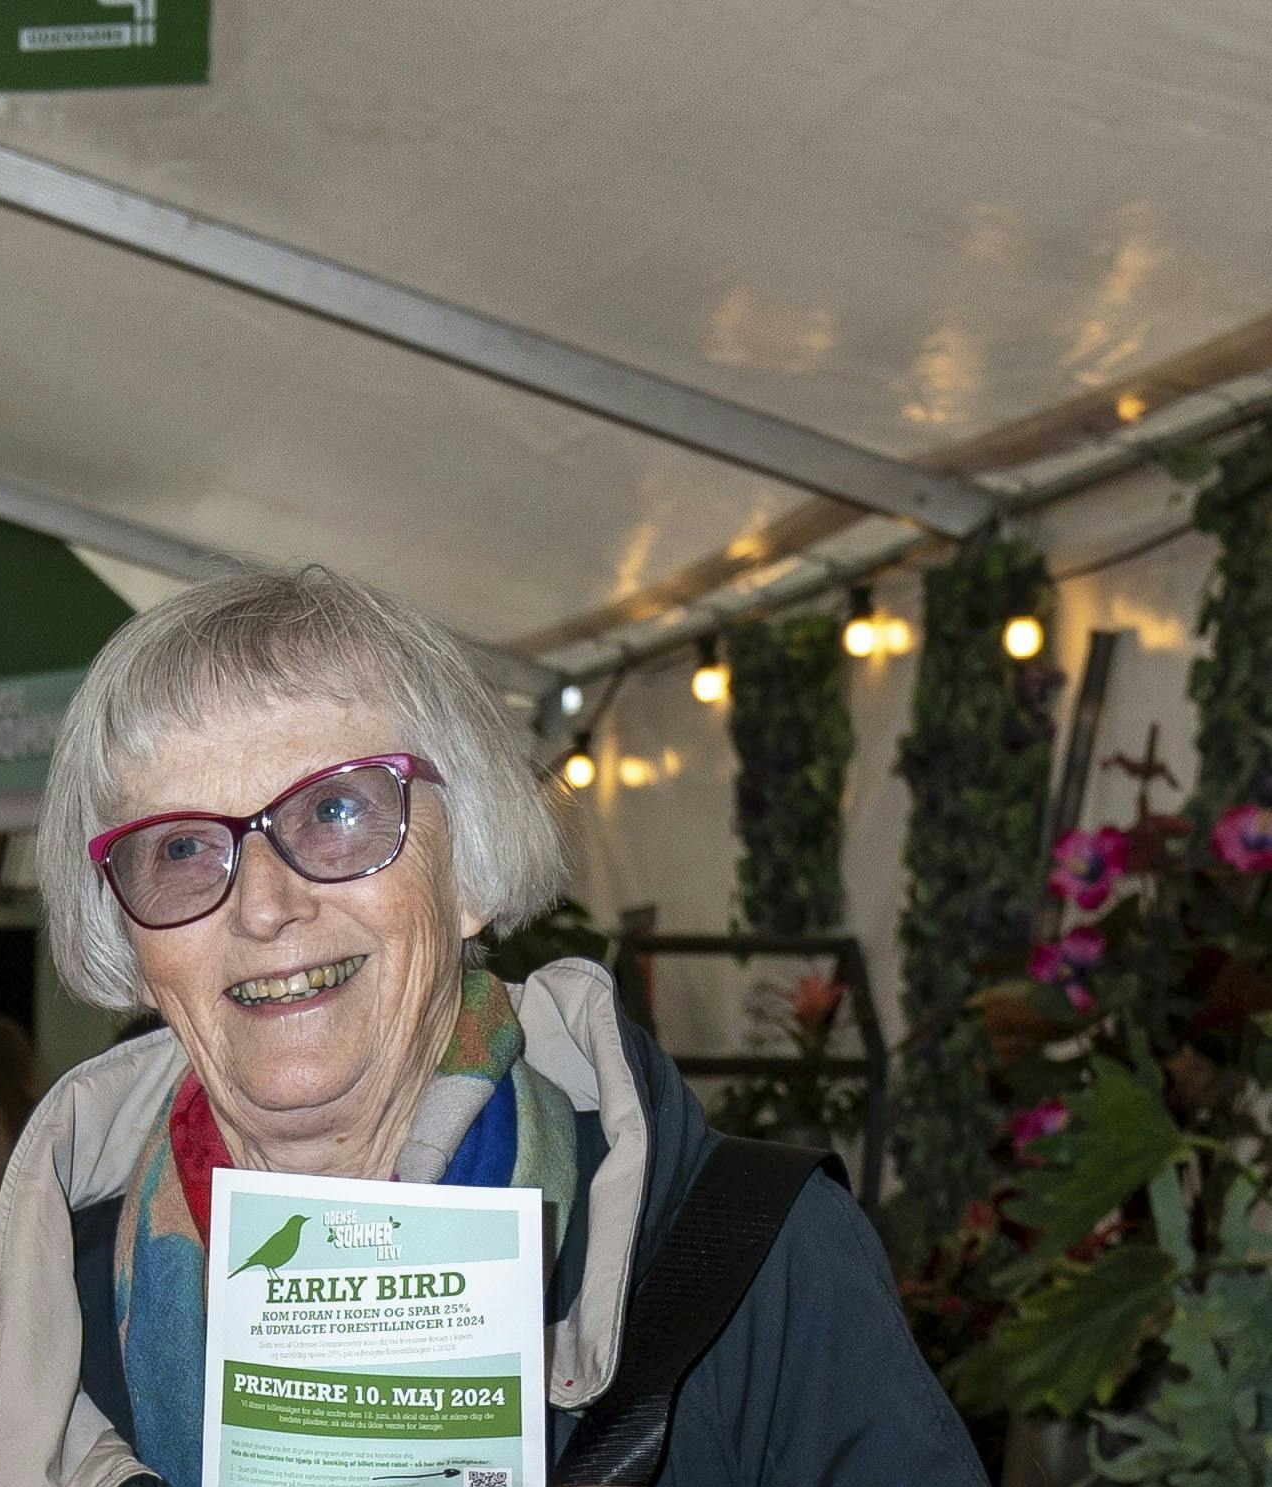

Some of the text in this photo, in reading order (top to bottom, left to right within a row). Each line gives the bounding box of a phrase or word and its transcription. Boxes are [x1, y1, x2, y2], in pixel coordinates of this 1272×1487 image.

[323, 1210, 358, 1226] ODENSE
[334, 1222, 393, 1249] SOMMER
[376, 1244, 402, 1261] REVY
[266, 1272, 466, 1304] EARLY BIRD
[262, 1303, 471, 1321] KOM FORAN I KØEN OG SPAR 25%
[250, 1315, 485, 1335] PÅ UDVALGTE FORESTILLINGER I 2024
[233, 1372, 506, 1411] PREMIERE 10. MAJ 2024
